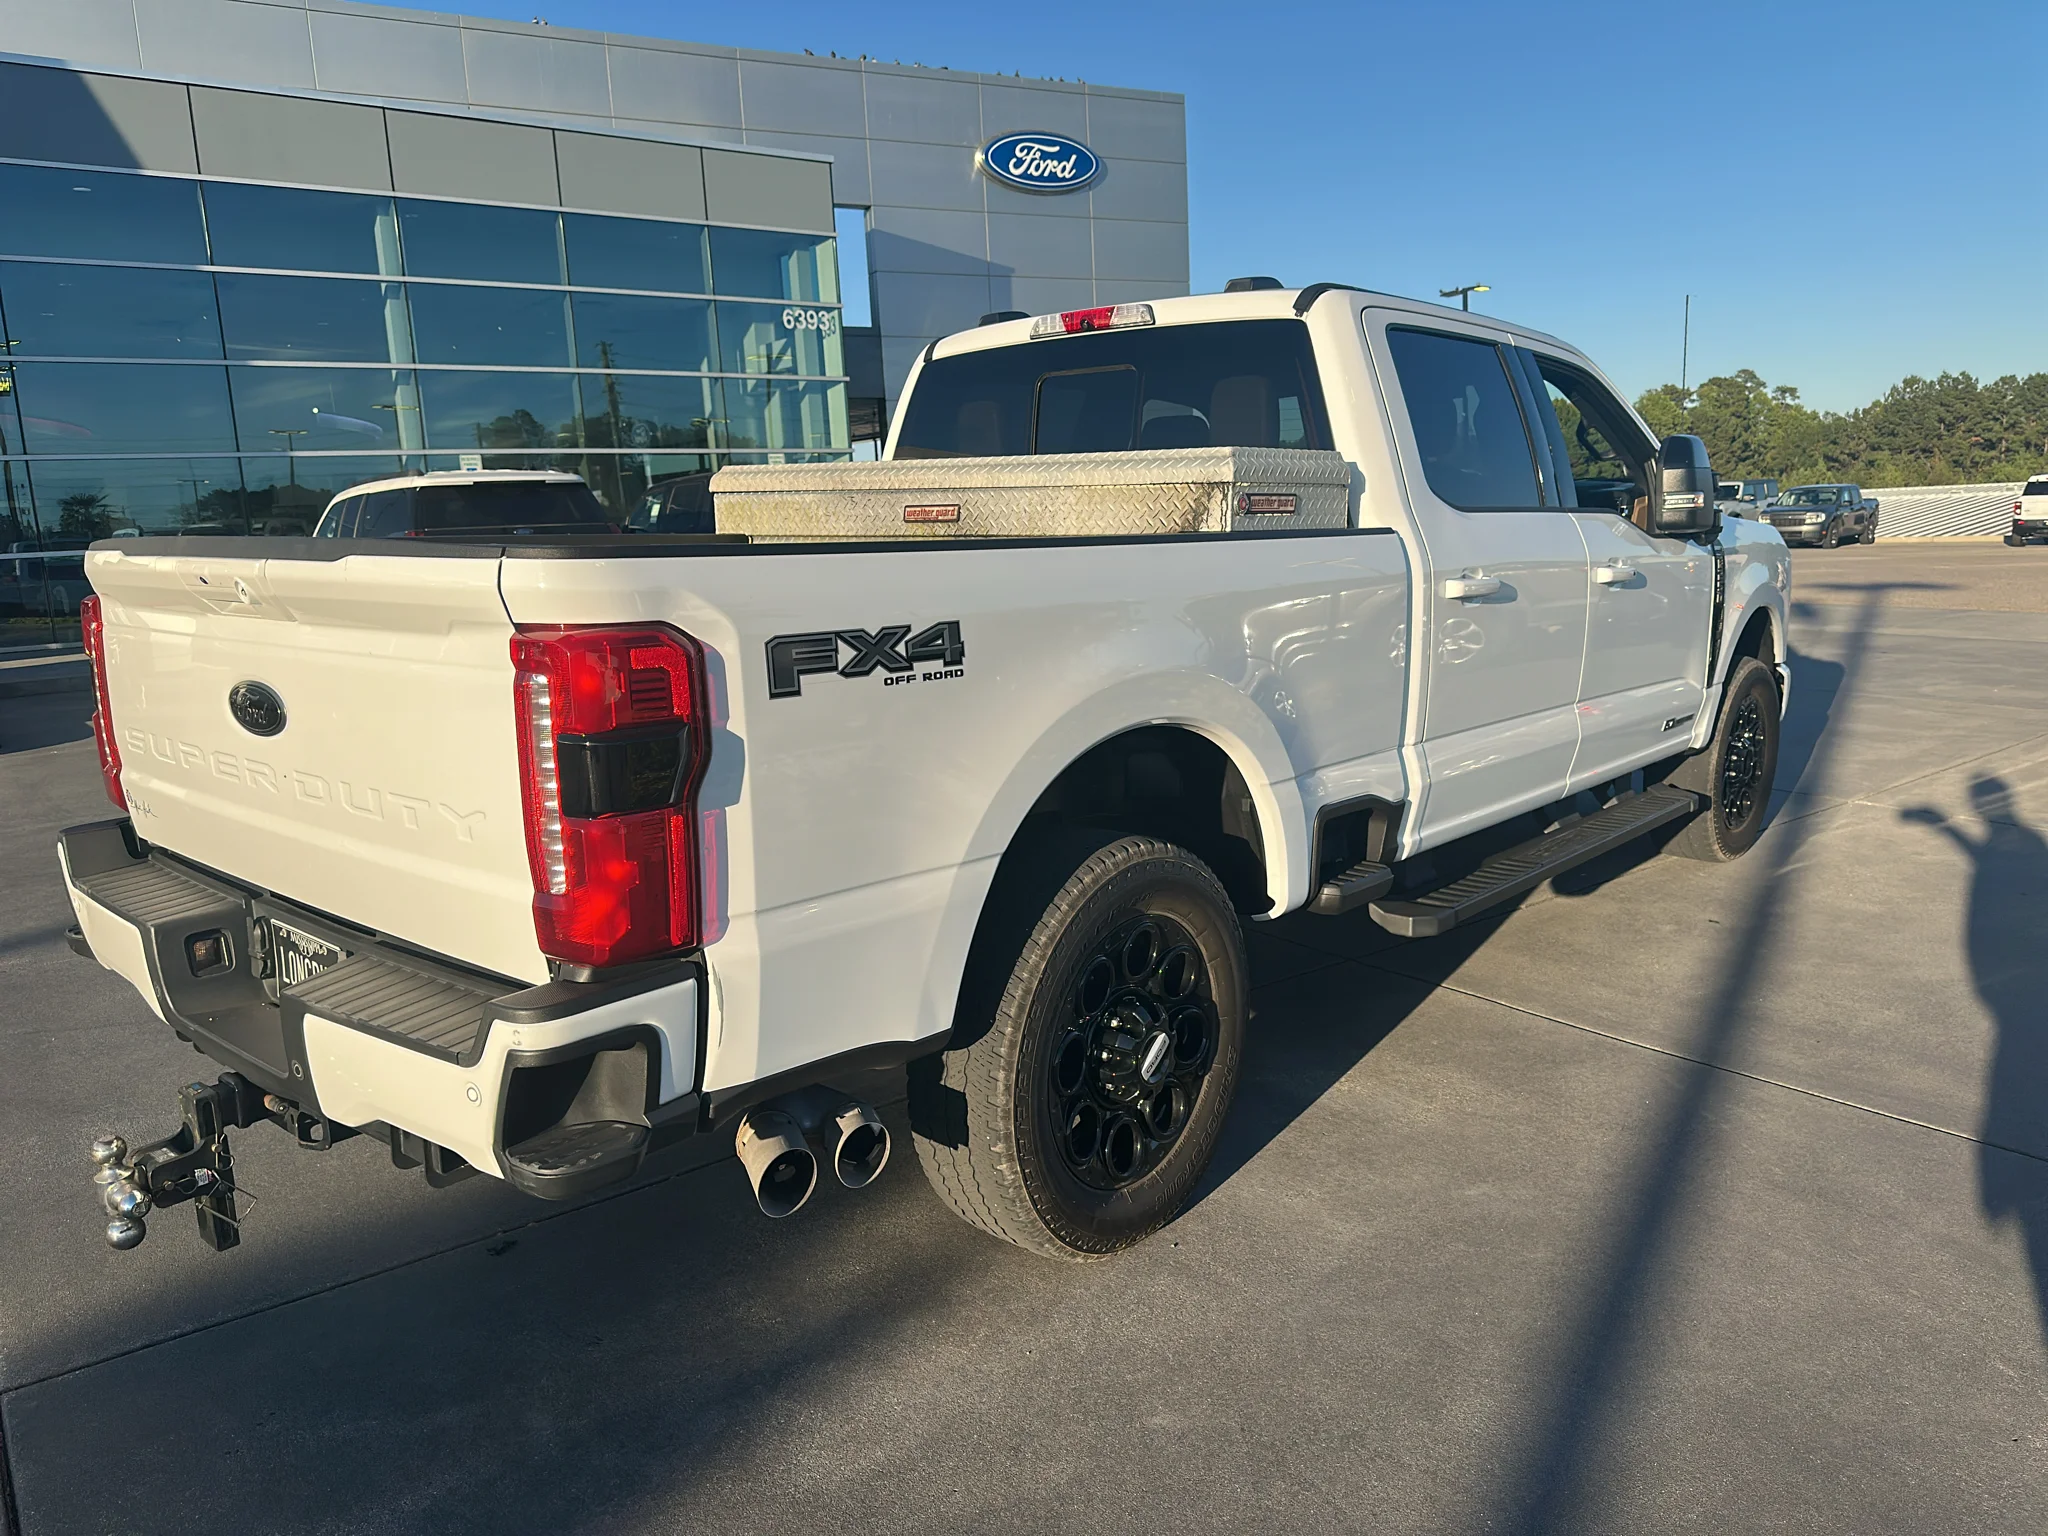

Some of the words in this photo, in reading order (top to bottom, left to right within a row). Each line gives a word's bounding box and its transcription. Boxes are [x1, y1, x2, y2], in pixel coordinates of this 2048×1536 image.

[1008, 142, 1077, 179] Ford
[782, 309, 830, 330] 6393
[906, 507, 935, 517] weather
[764, 620, 966, 700] FX4
[884, 674, 917, 686] OFF
[922, 668, 964, 682] ROAD
[125, 726, 279, 793] SUPER
[293, 769, 487, 843] DUTY
